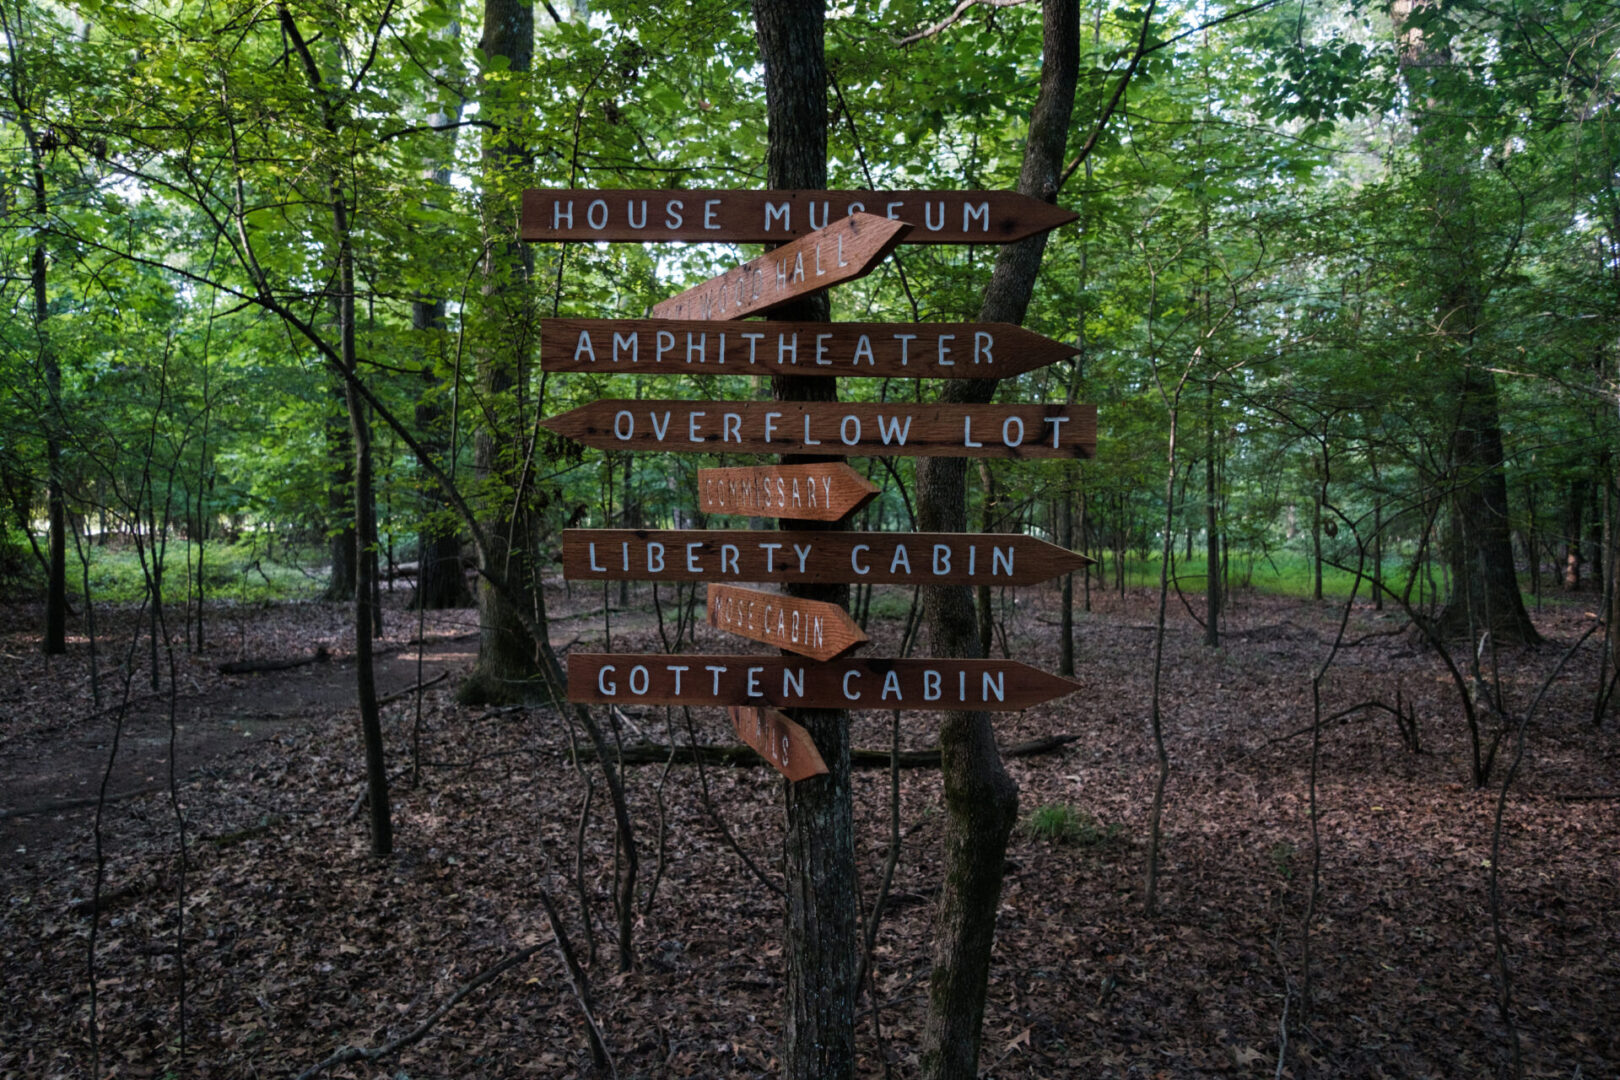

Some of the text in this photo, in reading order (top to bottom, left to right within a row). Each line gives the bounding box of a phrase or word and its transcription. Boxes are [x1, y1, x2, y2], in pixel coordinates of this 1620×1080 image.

[554, 199, 722, 230] HOUSE
[776, 233, 848, 292] HALL
[574, 330, 994, 366] AMPHITHEATER
[614, 410, 1070, 449] OVERFLOW LOT
[706, 475, 832, 509] COMMISSARY
[589, 541, 1014, 577] LIBERTY CABIN
[764, 604, 824, 649] CABIN
[598, 664, 1005, 702] GOTTEN CABIN
